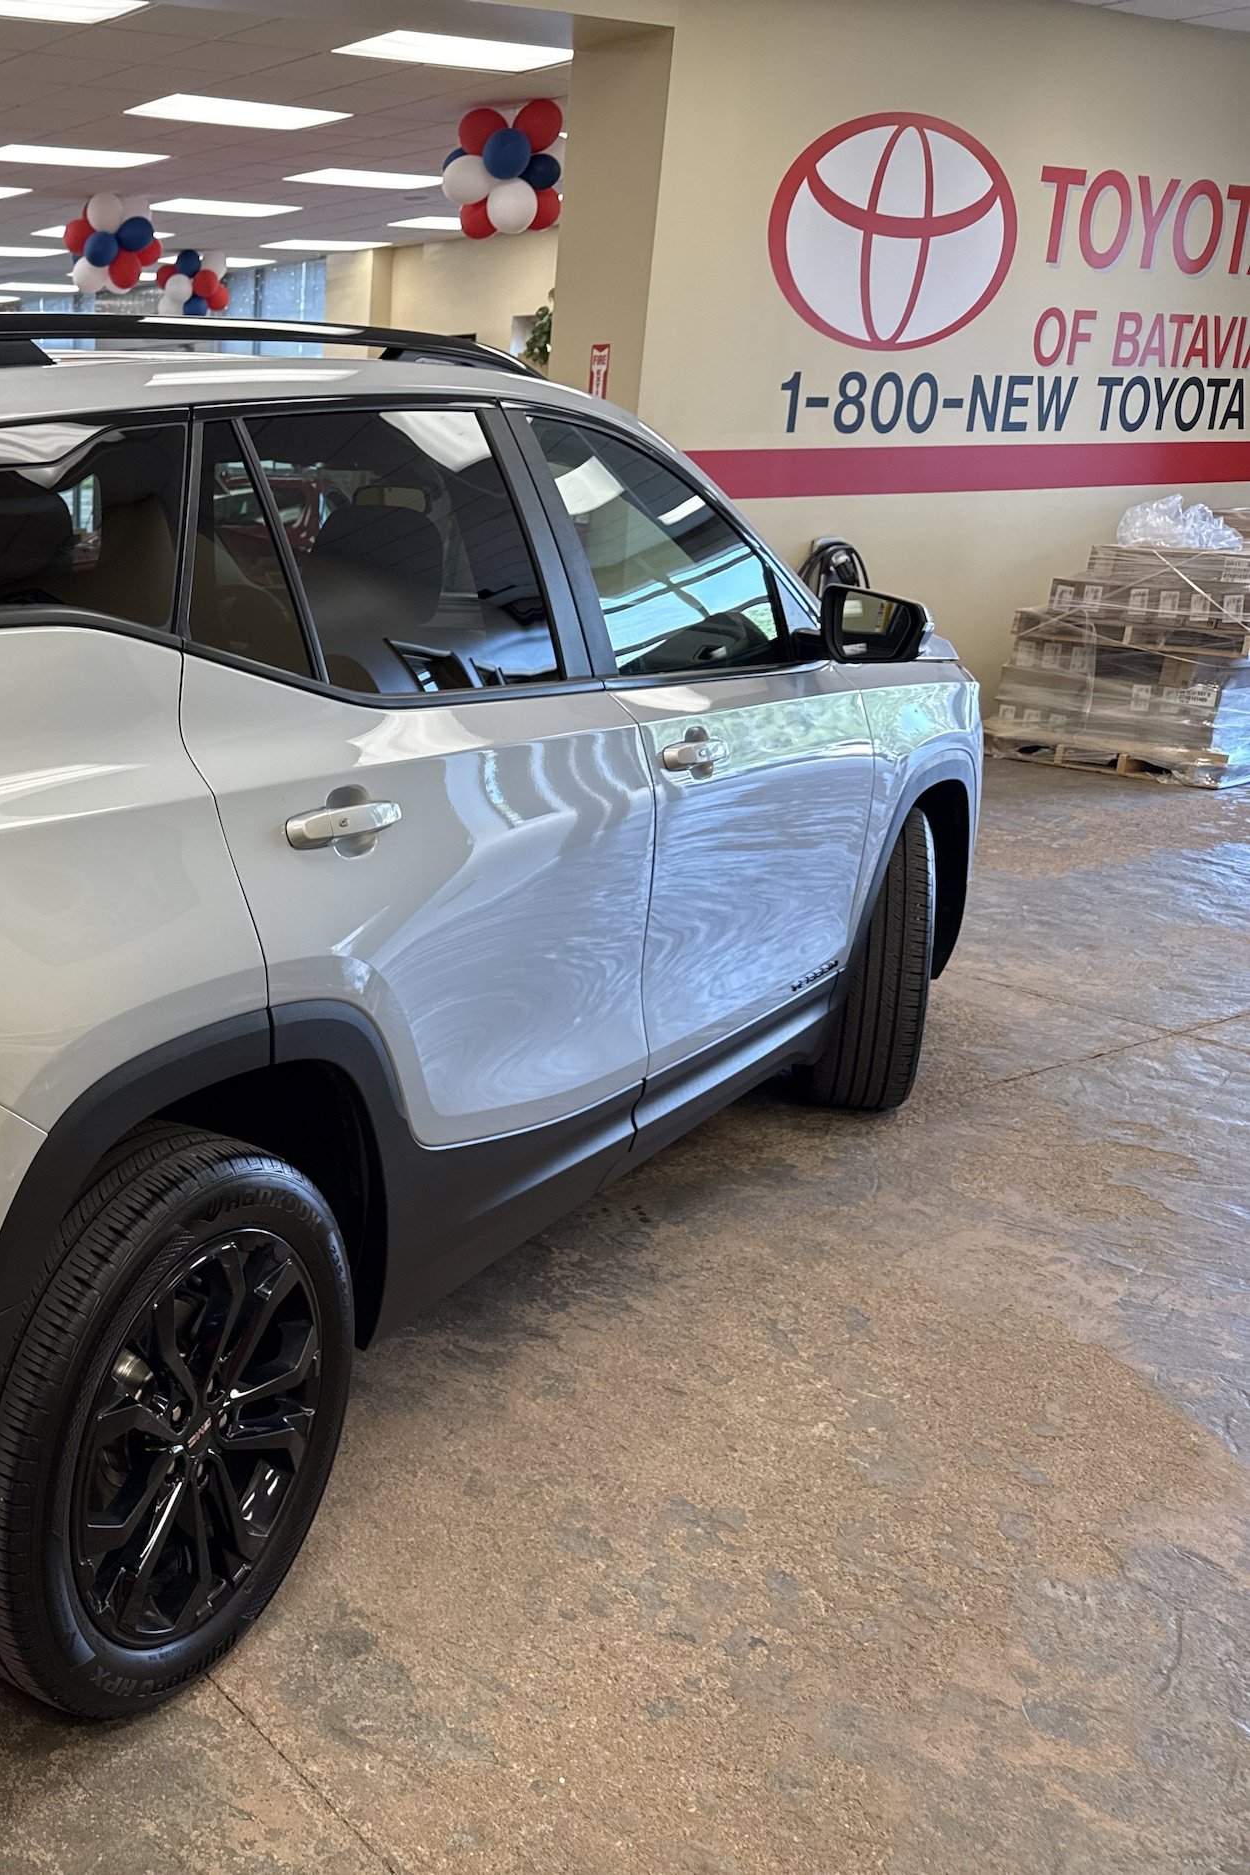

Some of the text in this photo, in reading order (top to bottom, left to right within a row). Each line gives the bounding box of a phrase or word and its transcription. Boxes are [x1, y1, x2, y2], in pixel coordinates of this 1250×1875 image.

[1041, 165, 1250, 275] TOYOT
[593, 354, 607, 366] FIRE
[1034, 307, 1097, 367] OF
[780, 371, 1244, 434] 1-800-NEW TOYOTA
